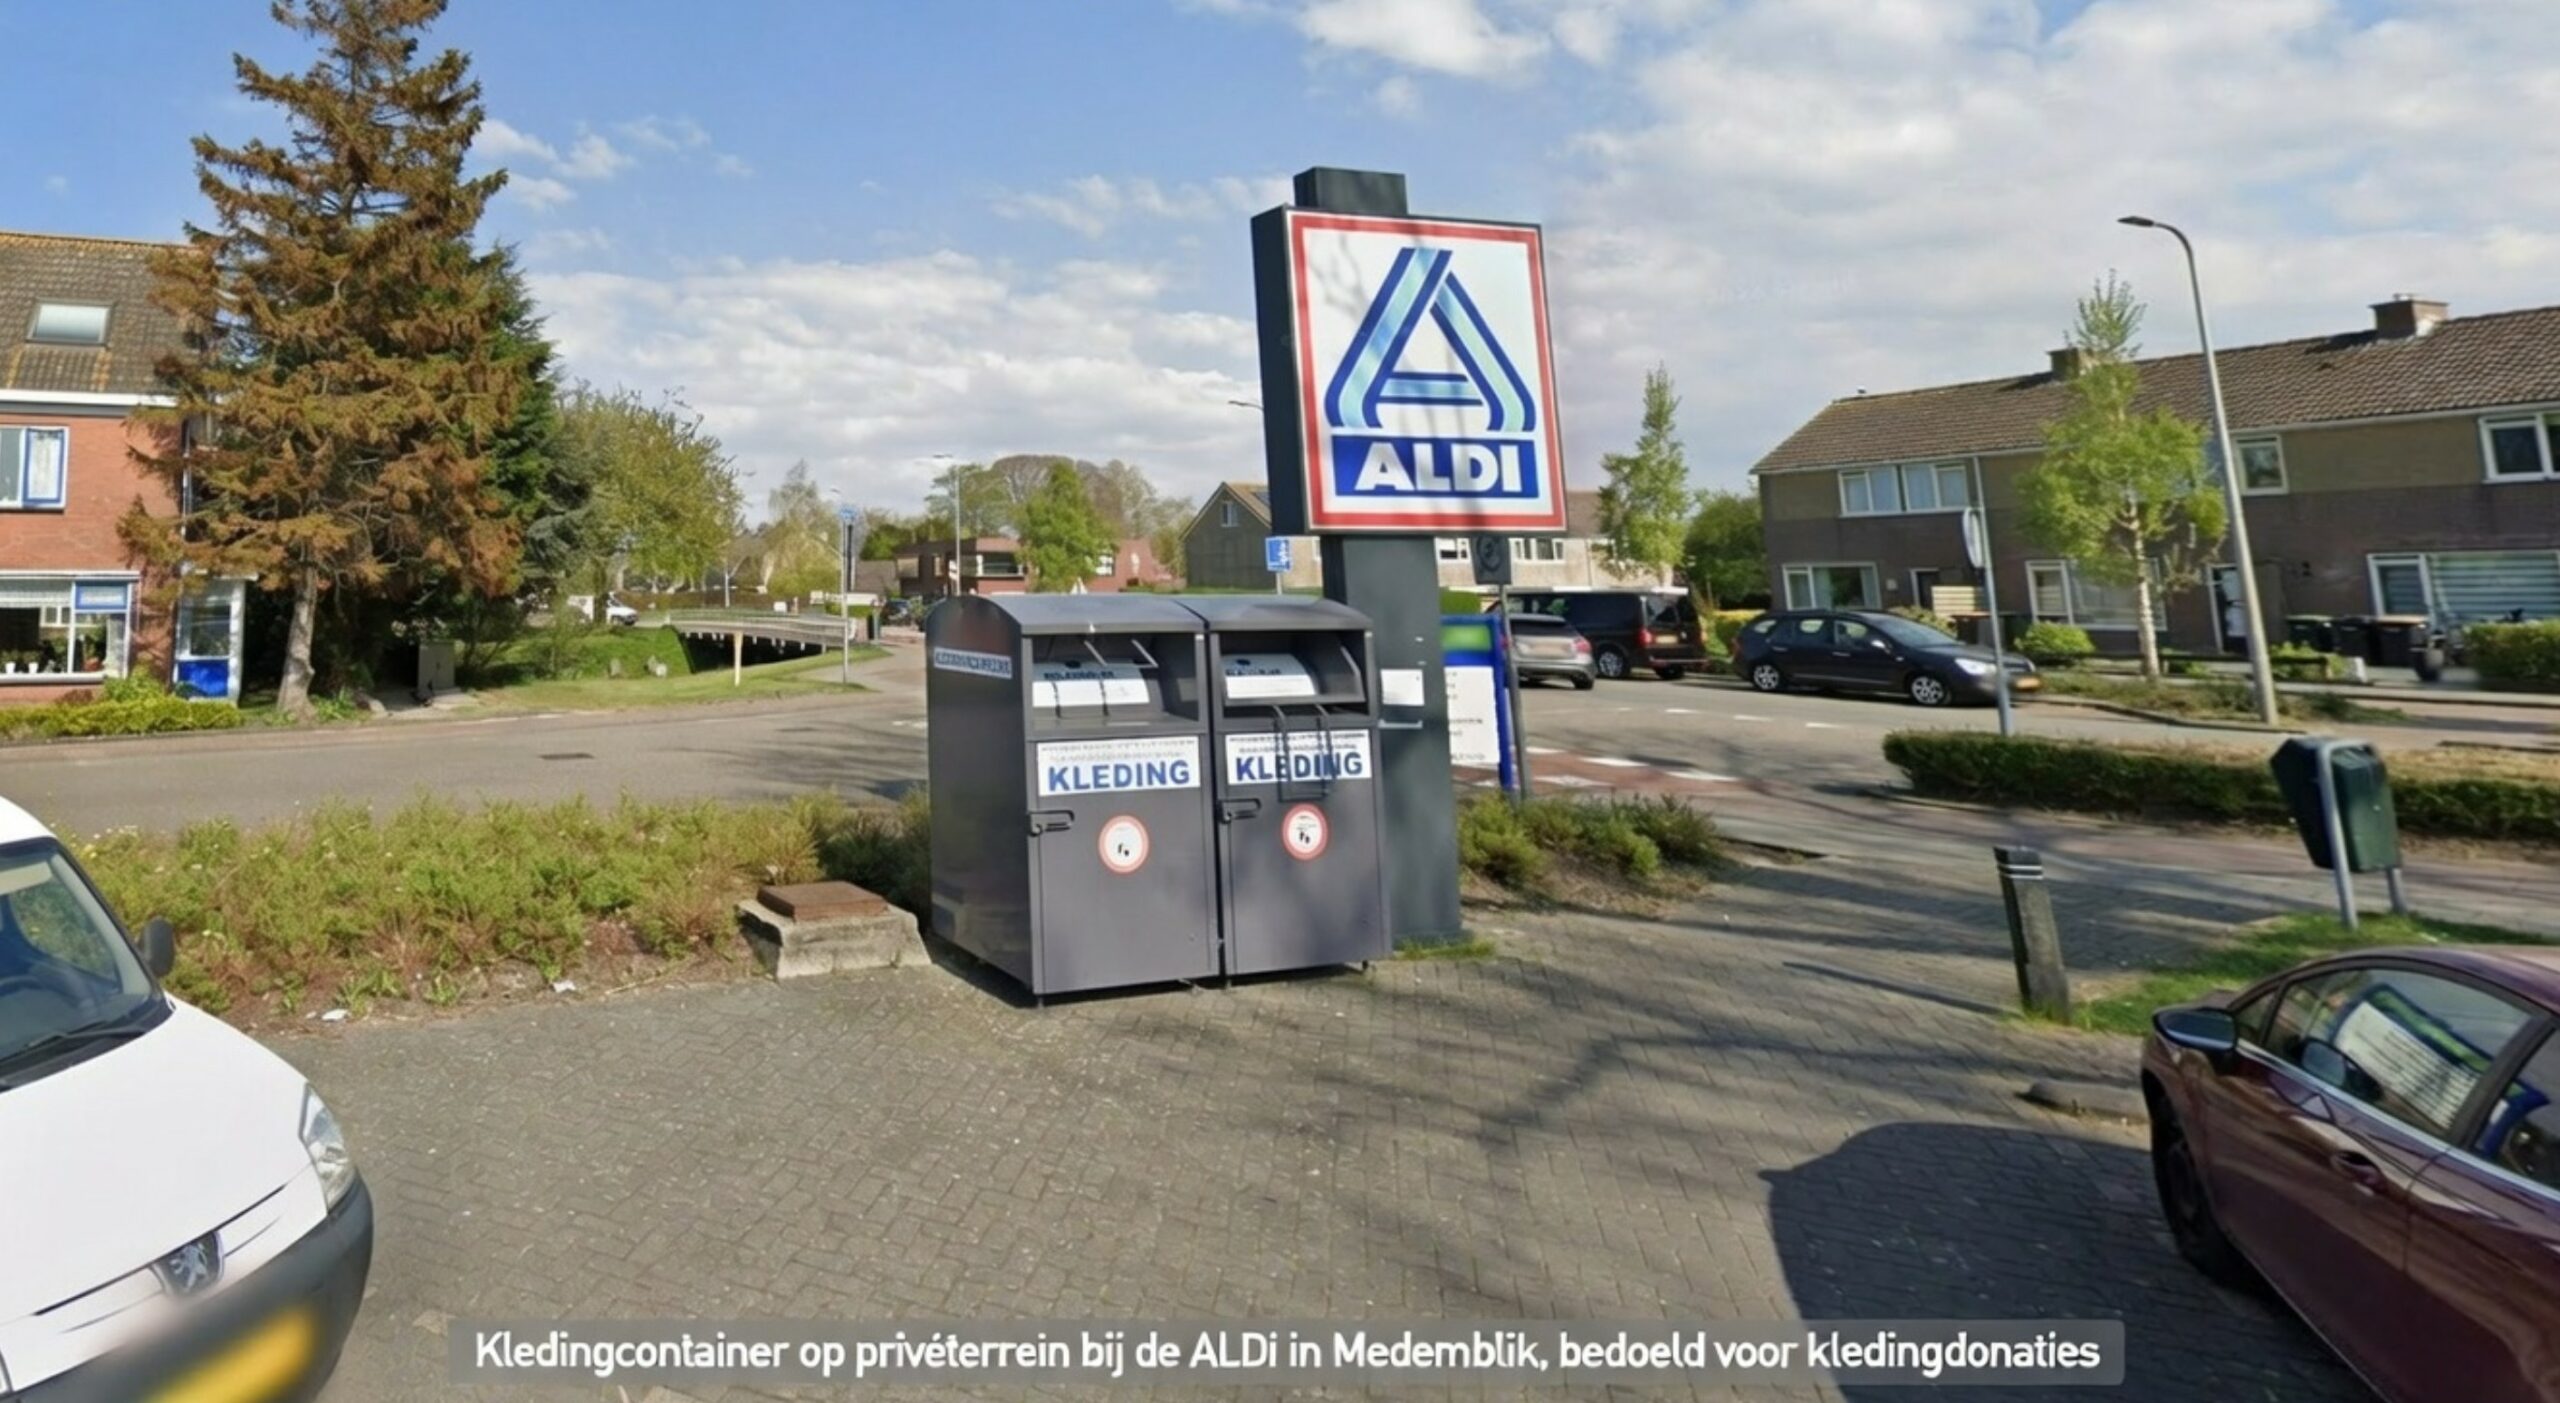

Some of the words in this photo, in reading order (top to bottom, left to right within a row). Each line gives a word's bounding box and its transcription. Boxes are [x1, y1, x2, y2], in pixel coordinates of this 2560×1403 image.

[1354, 442, 1522, 492] ALDI
[1047, 759, 1190, 792] KLEDING
[1235, 751, 1363, 782] KLEDING
